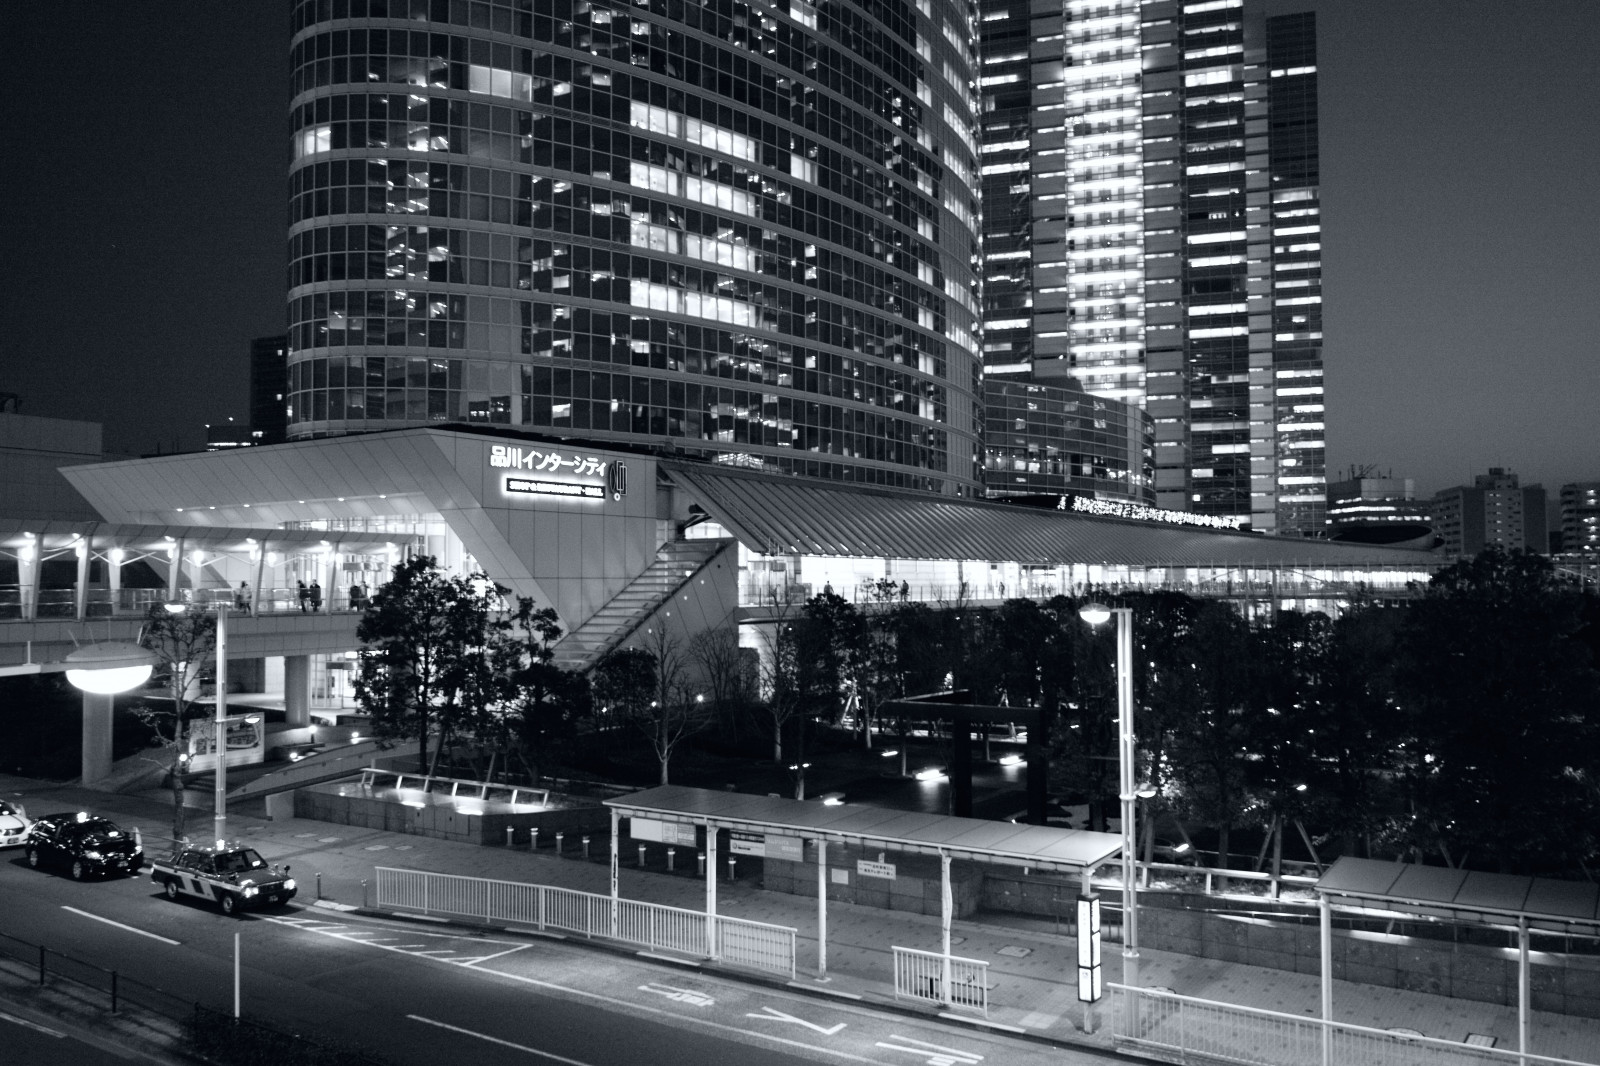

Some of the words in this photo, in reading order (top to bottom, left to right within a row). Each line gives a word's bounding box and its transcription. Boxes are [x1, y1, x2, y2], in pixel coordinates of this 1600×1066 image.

[490, 445, 607, 477] 品川インターシティ
